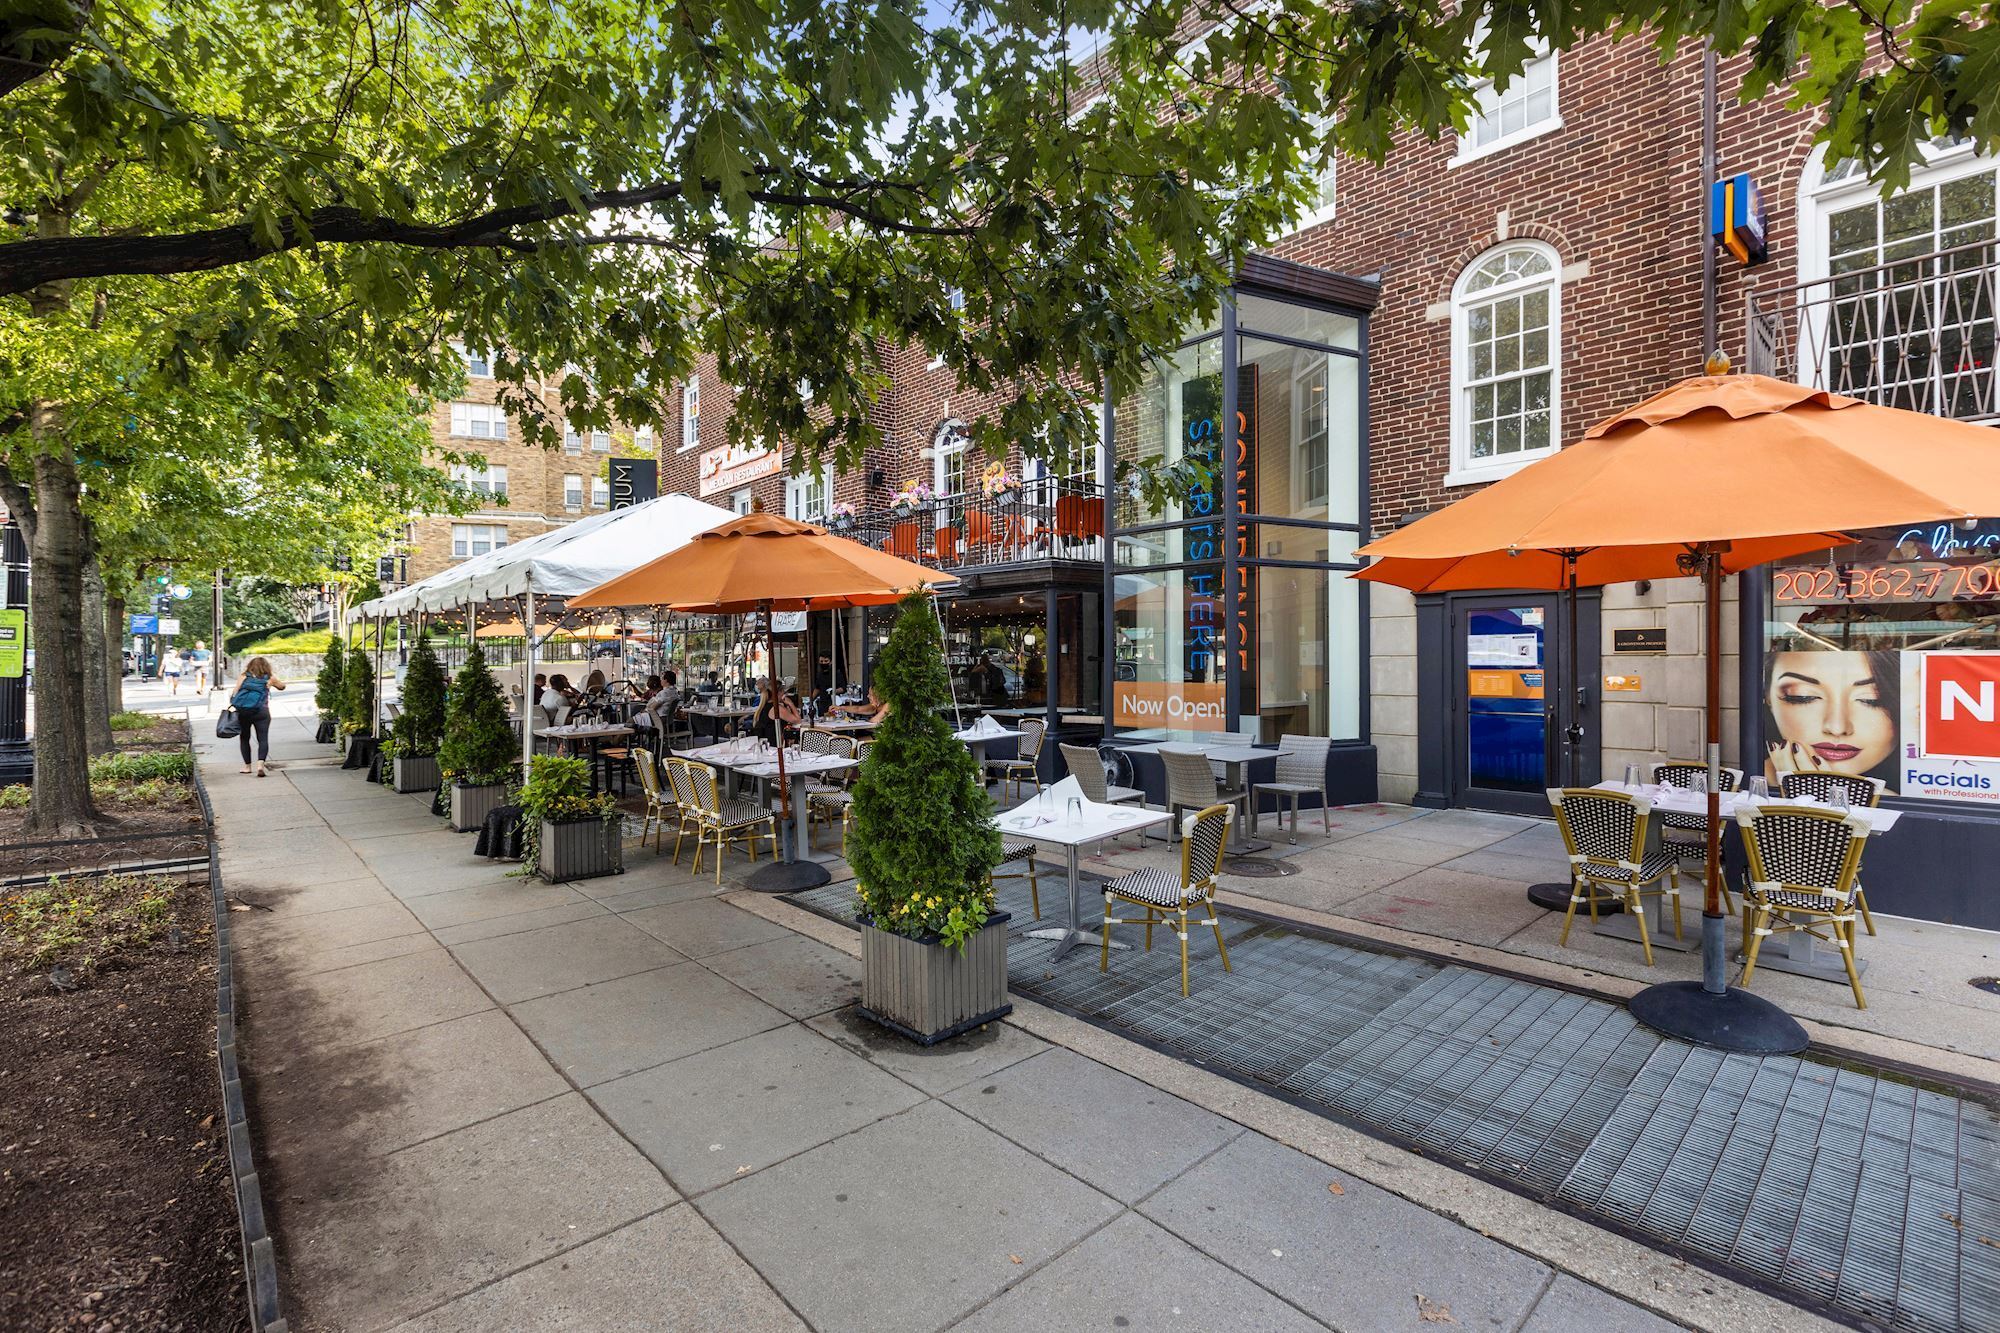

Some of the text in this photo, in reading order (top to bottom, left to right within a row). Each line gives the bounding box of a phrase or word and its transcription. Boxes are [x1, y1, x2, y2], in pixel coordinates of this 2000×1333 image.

[735, 459, 774, 482] RESTAURANT
[1189, 418, 1215, 672] SRTS HERE
[1774, 565, 2000, 600] 202-362-770
[1122, 694, 1226, 721] Now Open!
[1907, 769, 1991, 789] Facials
[1923, 788, 1999, 800] with Professional
